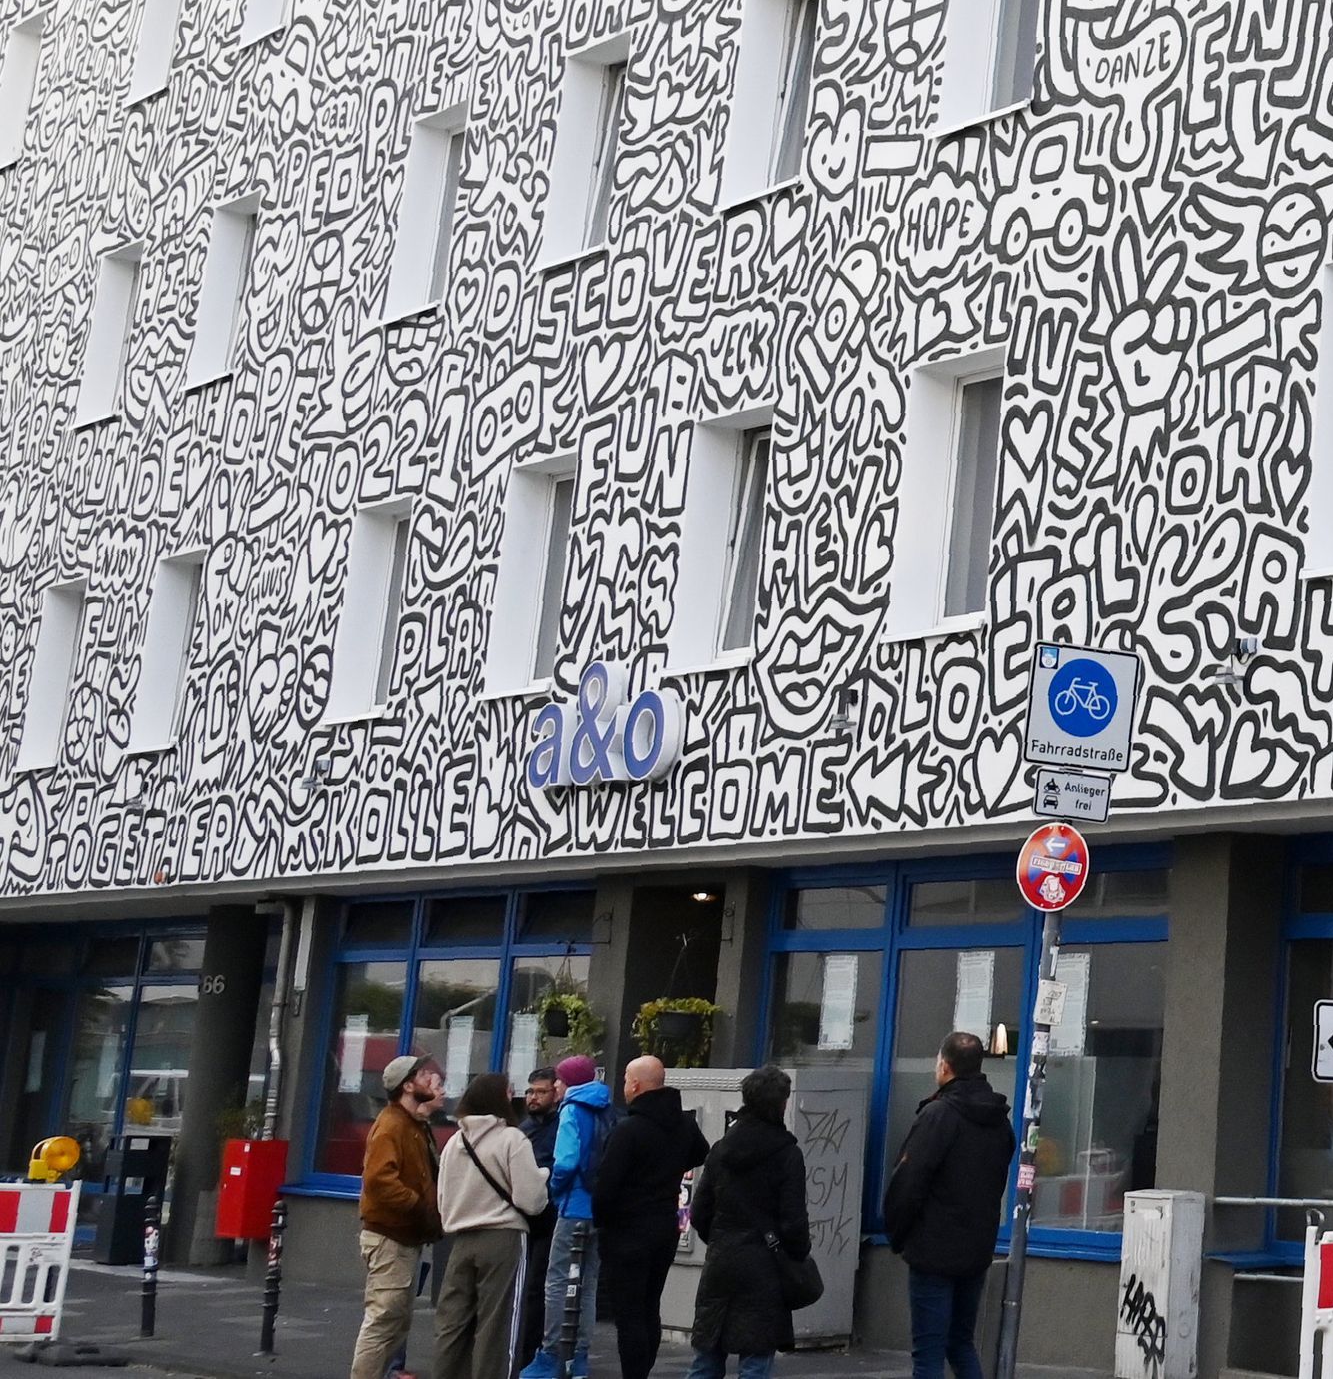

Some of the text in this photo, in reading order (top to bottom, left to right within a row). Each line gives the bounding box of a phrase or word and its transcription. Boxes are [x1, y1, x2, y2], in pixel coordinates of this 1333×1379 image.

[1095, 28, 1171, 96] DANZE
[907, 187, 973, 259] HOPE
[484, 174, 767, 381] DISCOVER
[709, 309, 769, 389] JECK
[572, 379, 694, 536] FUN
[95, 535, 136, 583] ENJOY
[762, 452, 882, 612] HEY
[76, 586, 143, 680] FUN
[213, 600, 231, 636] OK
[530, 661, 668, 788] a&o
[1031, 738, 1124, 762] Fahrradstraße
[325, 737, 475, 868] KÖLLE
[575, 736, 854, 851] WELCOME
[1064, 780, 1106, 797] Anlieger
[1074, 798, 1092, 811] frei
[45, 795, 233, 891] TOGETHER
[203, 974, 225, 994] 66
